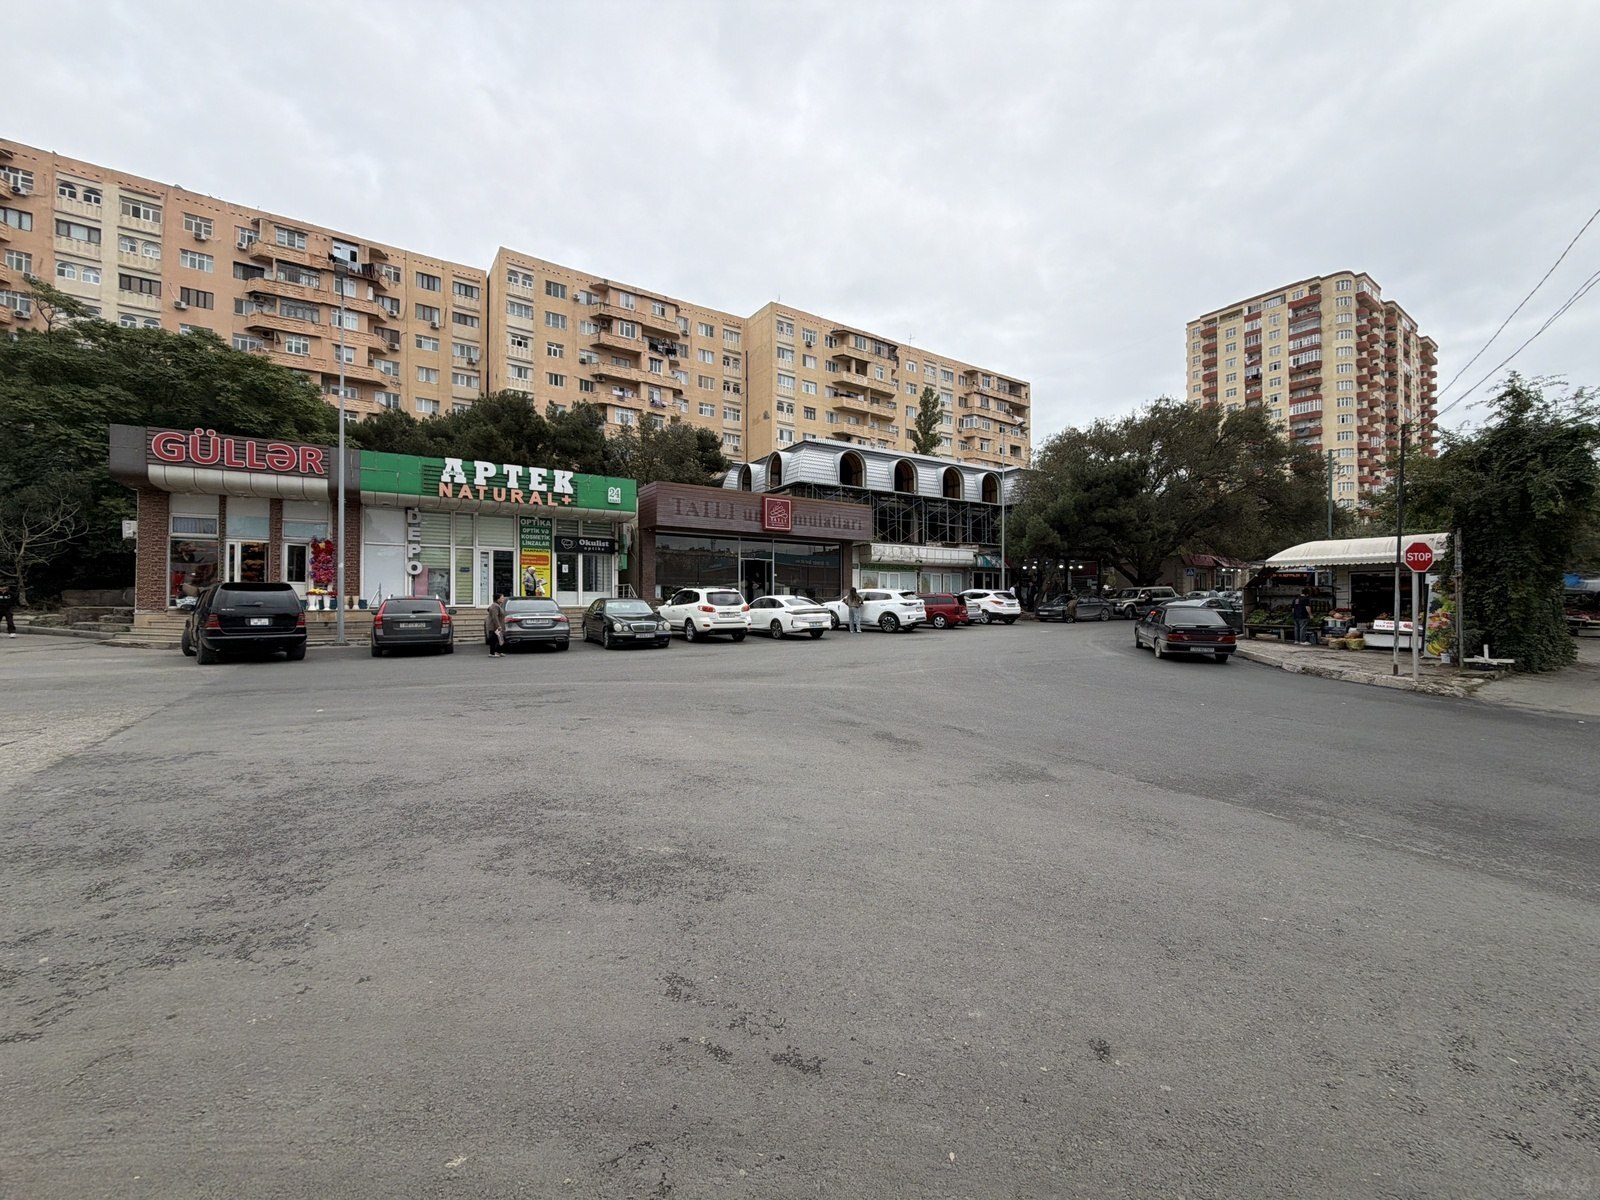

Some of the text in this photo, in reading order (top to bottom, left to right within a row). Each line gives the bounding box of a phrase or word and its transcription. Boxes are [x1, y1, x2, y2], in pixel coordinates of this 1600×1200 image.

[152, 427, 324, 474] GÜLLƏR
[441, 457, 574, 494] APTEK
[609, 488, 620, 498] 24
[406, 509, 423, 575] DEPO
[578, 539, 609, 547] Okulist
[1406, 552, 1432, 561] STOP
